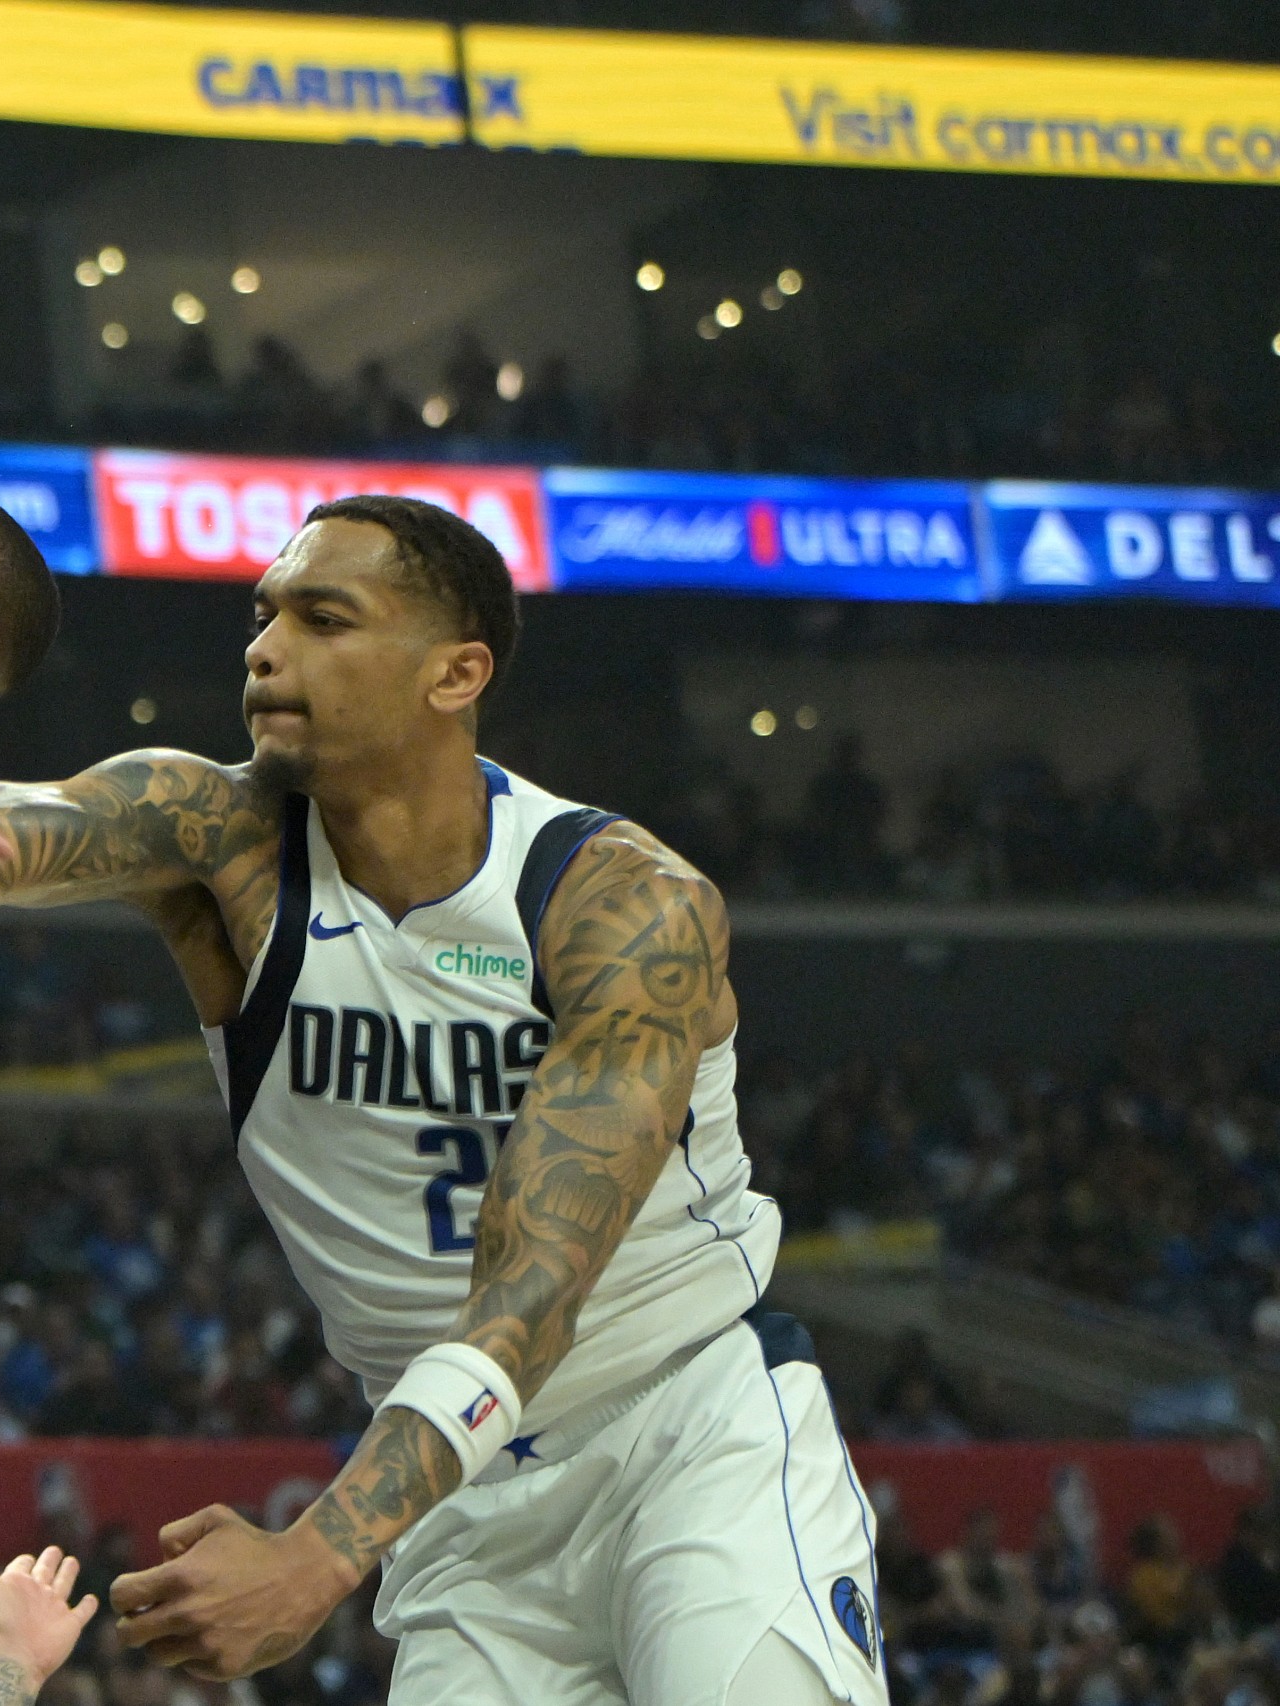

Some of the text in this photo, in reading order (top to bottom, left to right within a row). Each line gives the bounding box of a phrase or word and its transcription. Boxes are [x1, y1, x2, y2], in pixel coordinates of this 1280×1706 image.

[780, 78, 920, 160] Visit
[780, 506, 968, 569] ULTRA
[1104, 509, 1280, 583] DEL
[435, 943, 526, 981] chime
[288, 1001, 554, 1118] DALLAS
[415, 1121, 514, 1256] 2
